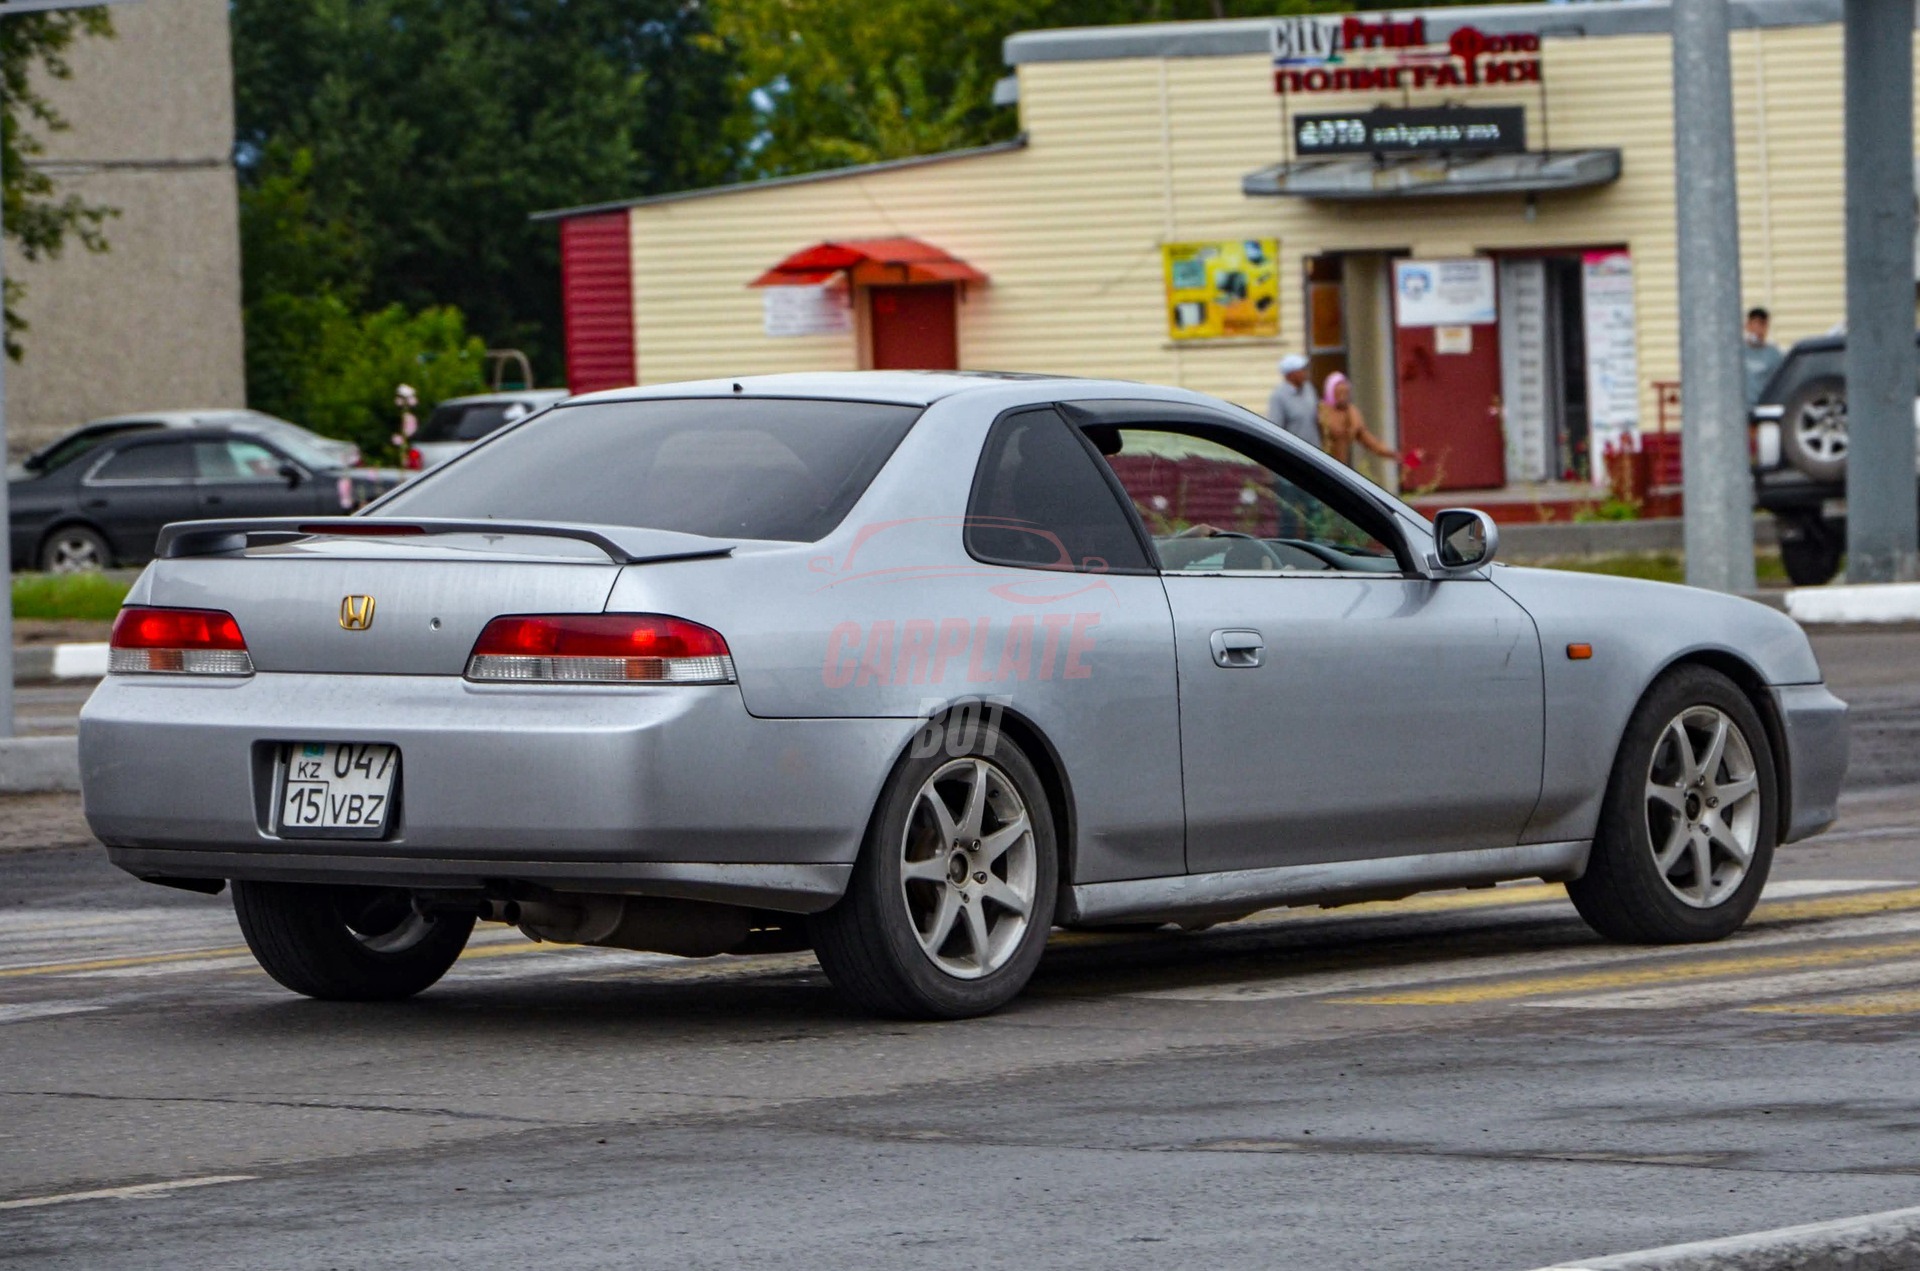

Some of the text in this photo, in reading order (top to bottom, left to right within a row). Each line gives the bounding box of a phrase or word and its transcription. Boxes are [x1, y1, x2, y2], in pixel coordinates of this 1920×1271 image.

[298, 762, 321, 778] KZ
[289, 787, 385, 825] 15 VBZ
